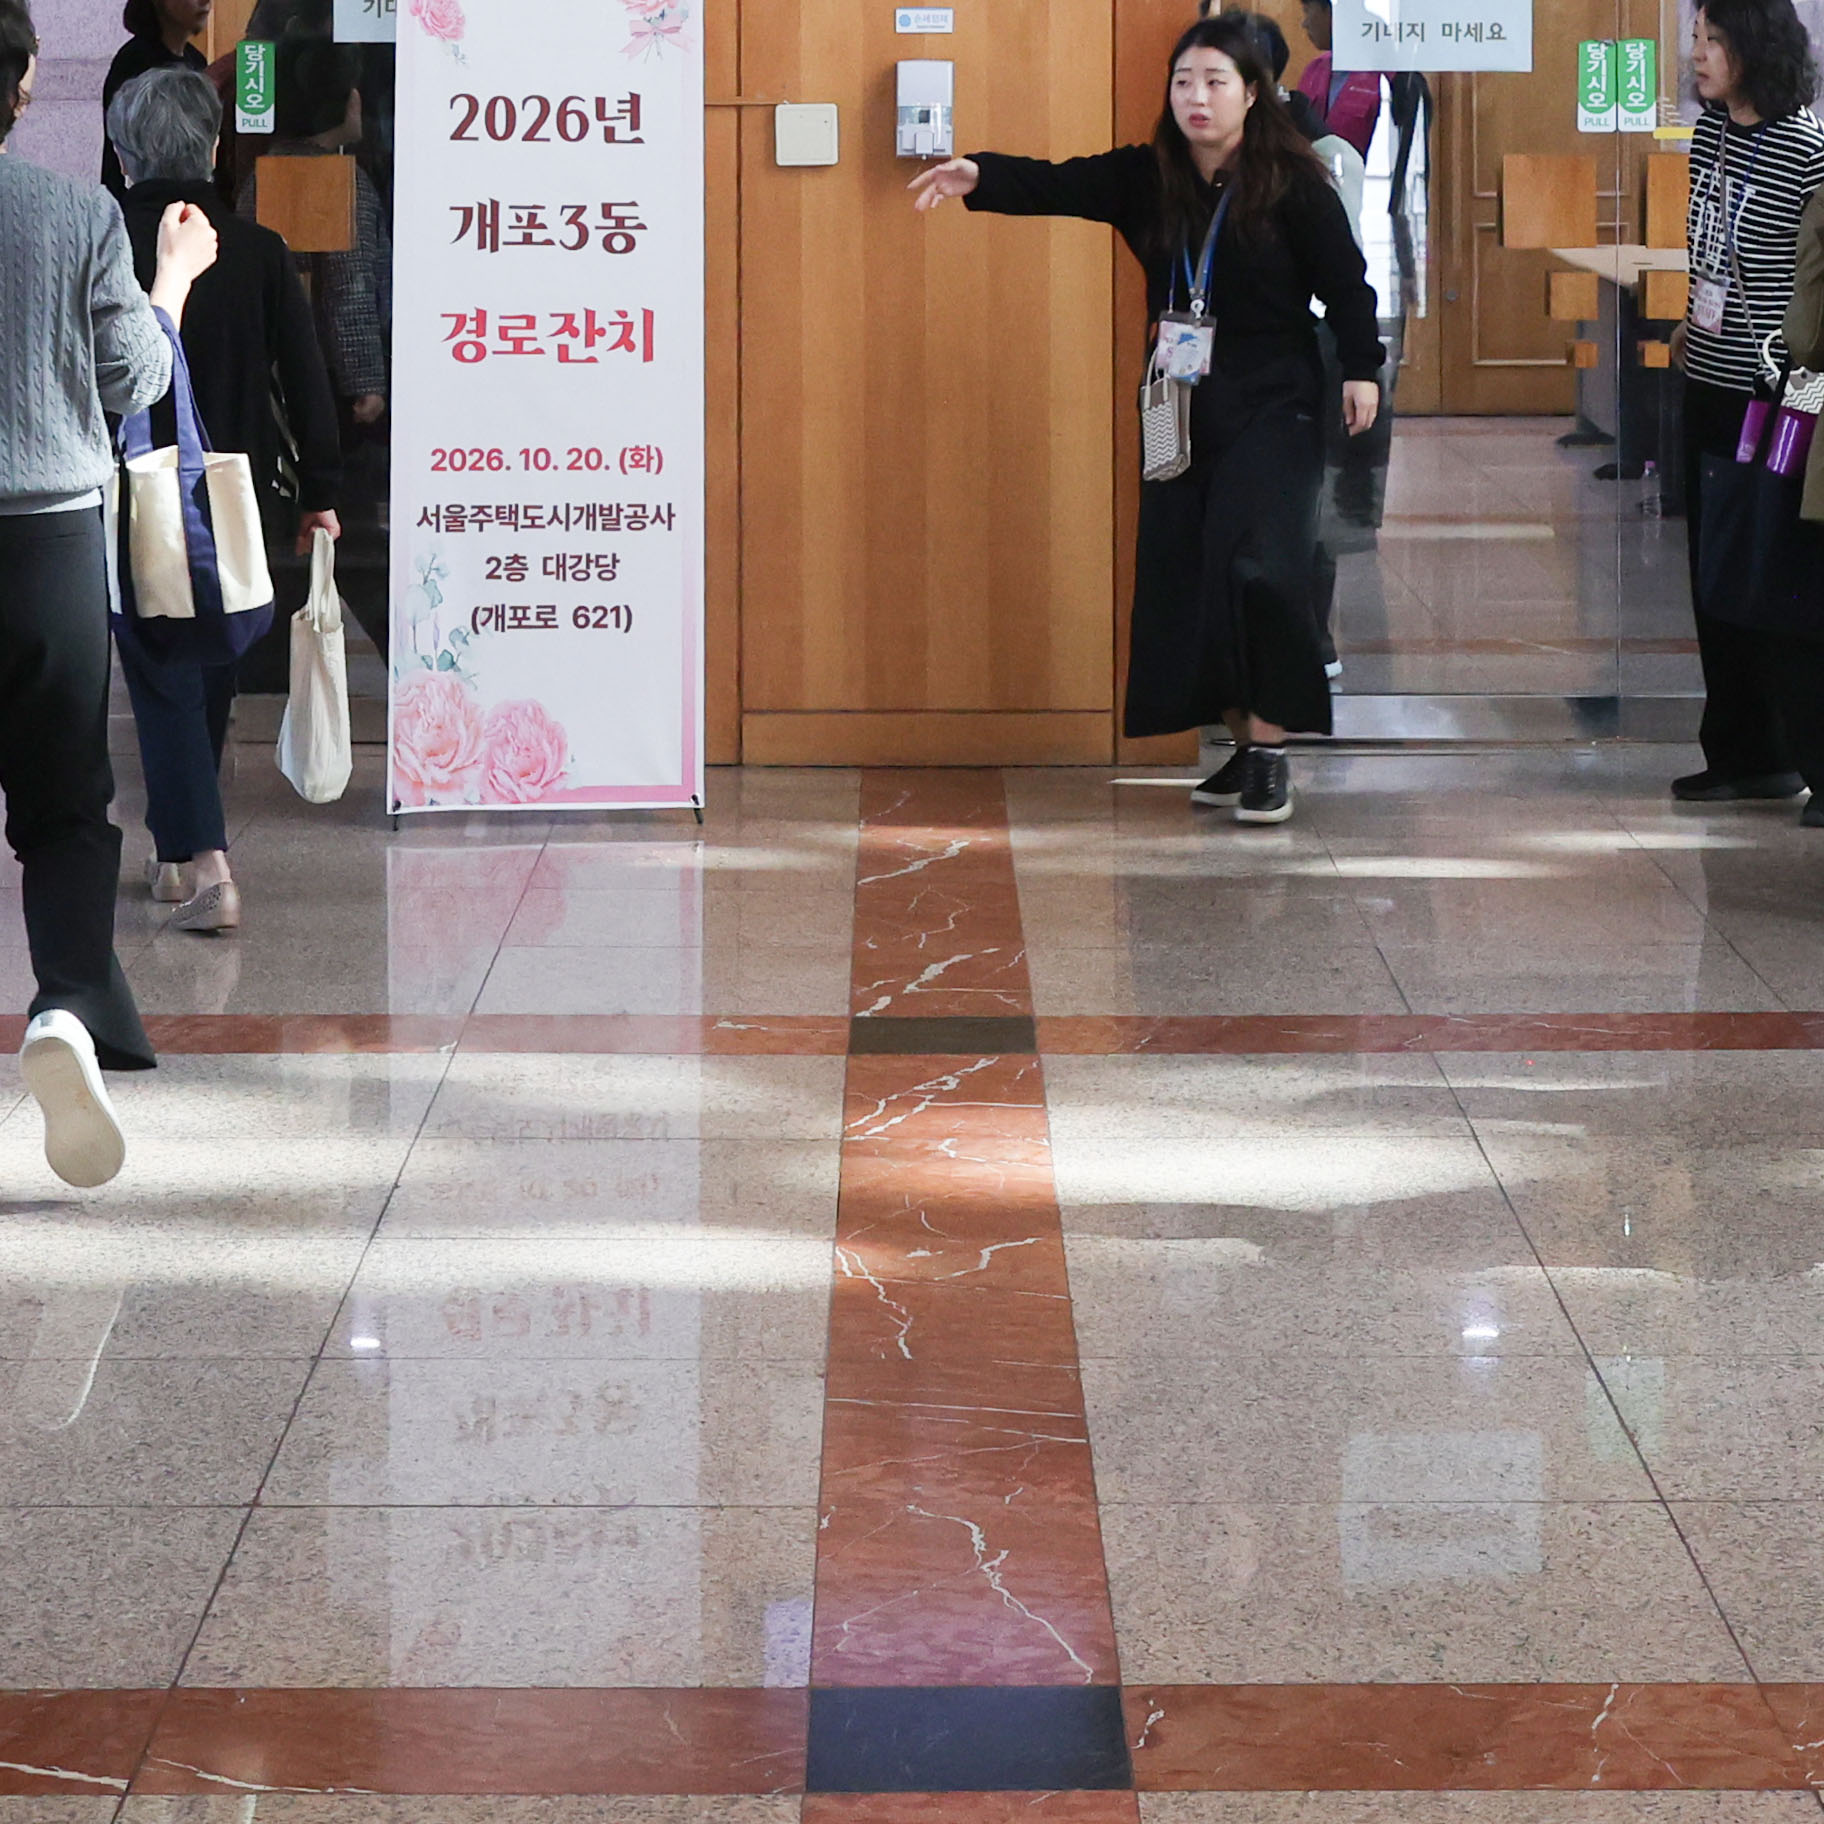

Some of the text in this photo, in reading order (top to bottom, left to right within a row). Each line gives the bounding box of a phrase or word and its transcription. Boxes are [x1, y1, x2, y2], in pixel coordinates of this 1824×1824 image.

[1441, 22, 1507, 43] 마세요
[244, 43, 267, 109] 당기시오
[1586, 43, 1608, 108] 당기시오
[1625, 41, 1648, 108] 당기시오
[242, 118, 268, 128] PULL
[449, 91, 645, 145] 2026년
[1584, 117, 1609, 127] PULL
[1624, 117, 1649, 126] PULL
[449, 198, 648, 255] 개포3동
[440, 307, 655, 364] 경로잔치
[430, 444, 664, 476] 2026. 10. 20. (화)
[416, 502, 676, 534] 서울주택도시개발공사
[485, 552, 621, 583] 2층 대강당
[469, 603, 633, 635] (개포로 621)
